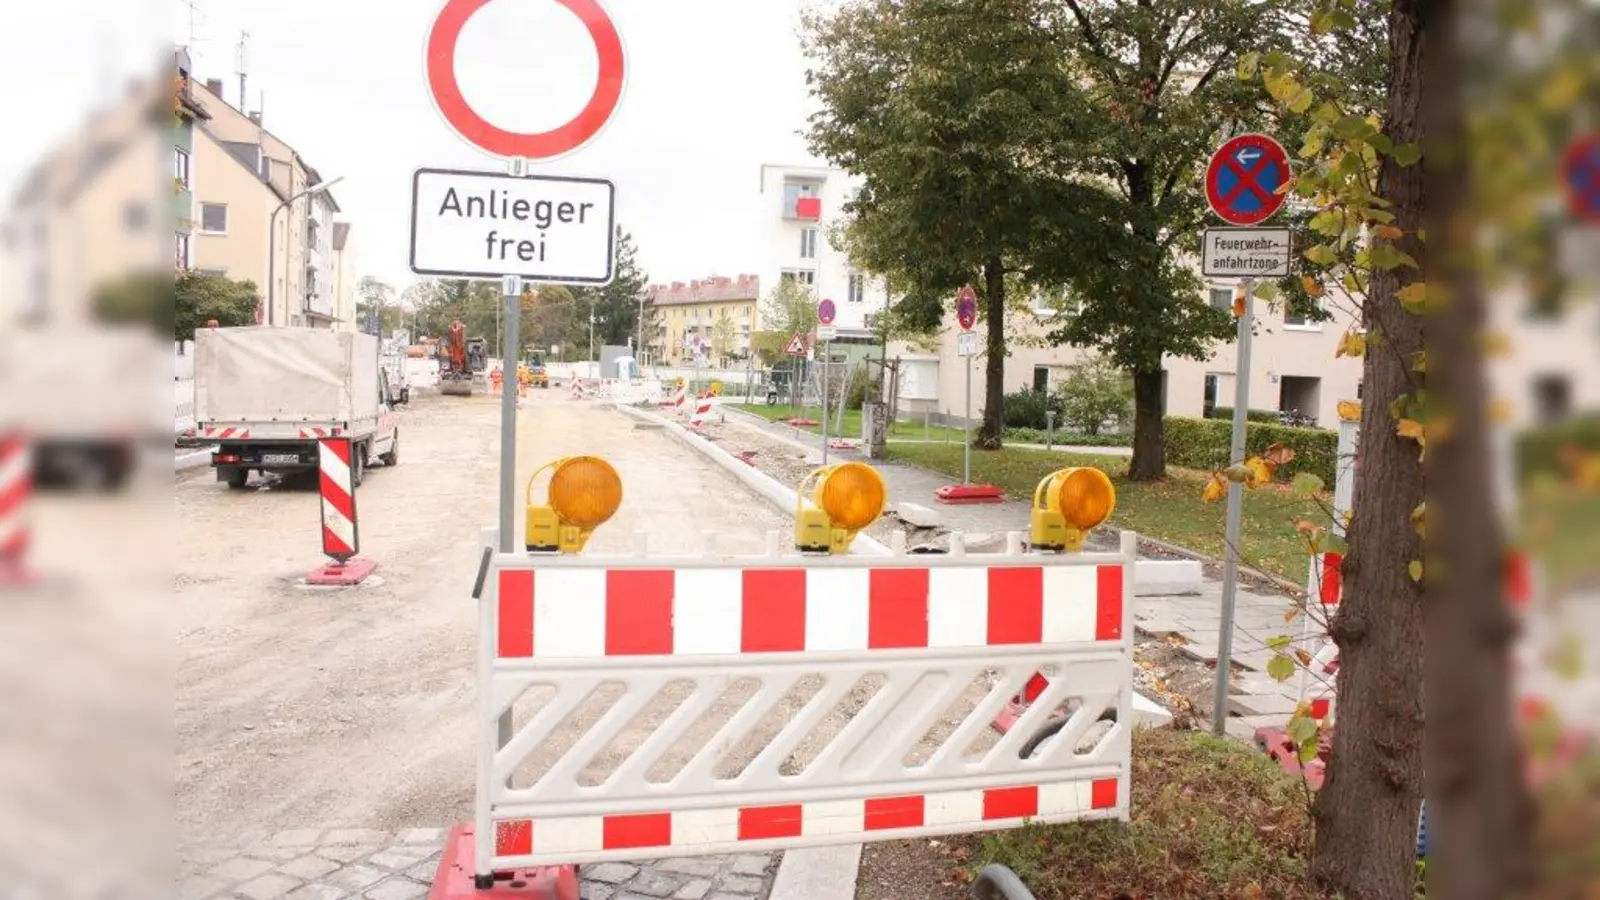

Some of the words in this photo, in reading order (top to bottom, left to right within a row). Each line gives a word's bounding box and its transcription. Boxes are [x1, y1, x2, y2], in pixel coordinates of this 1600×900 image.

[438, 187, 594, 229] Anlieger
[486, 231, 546, 262] frei
[1215, 237, 1279, 250] Feuerwehr-
[1213, 256, 1279, 269] anfahrtzone
